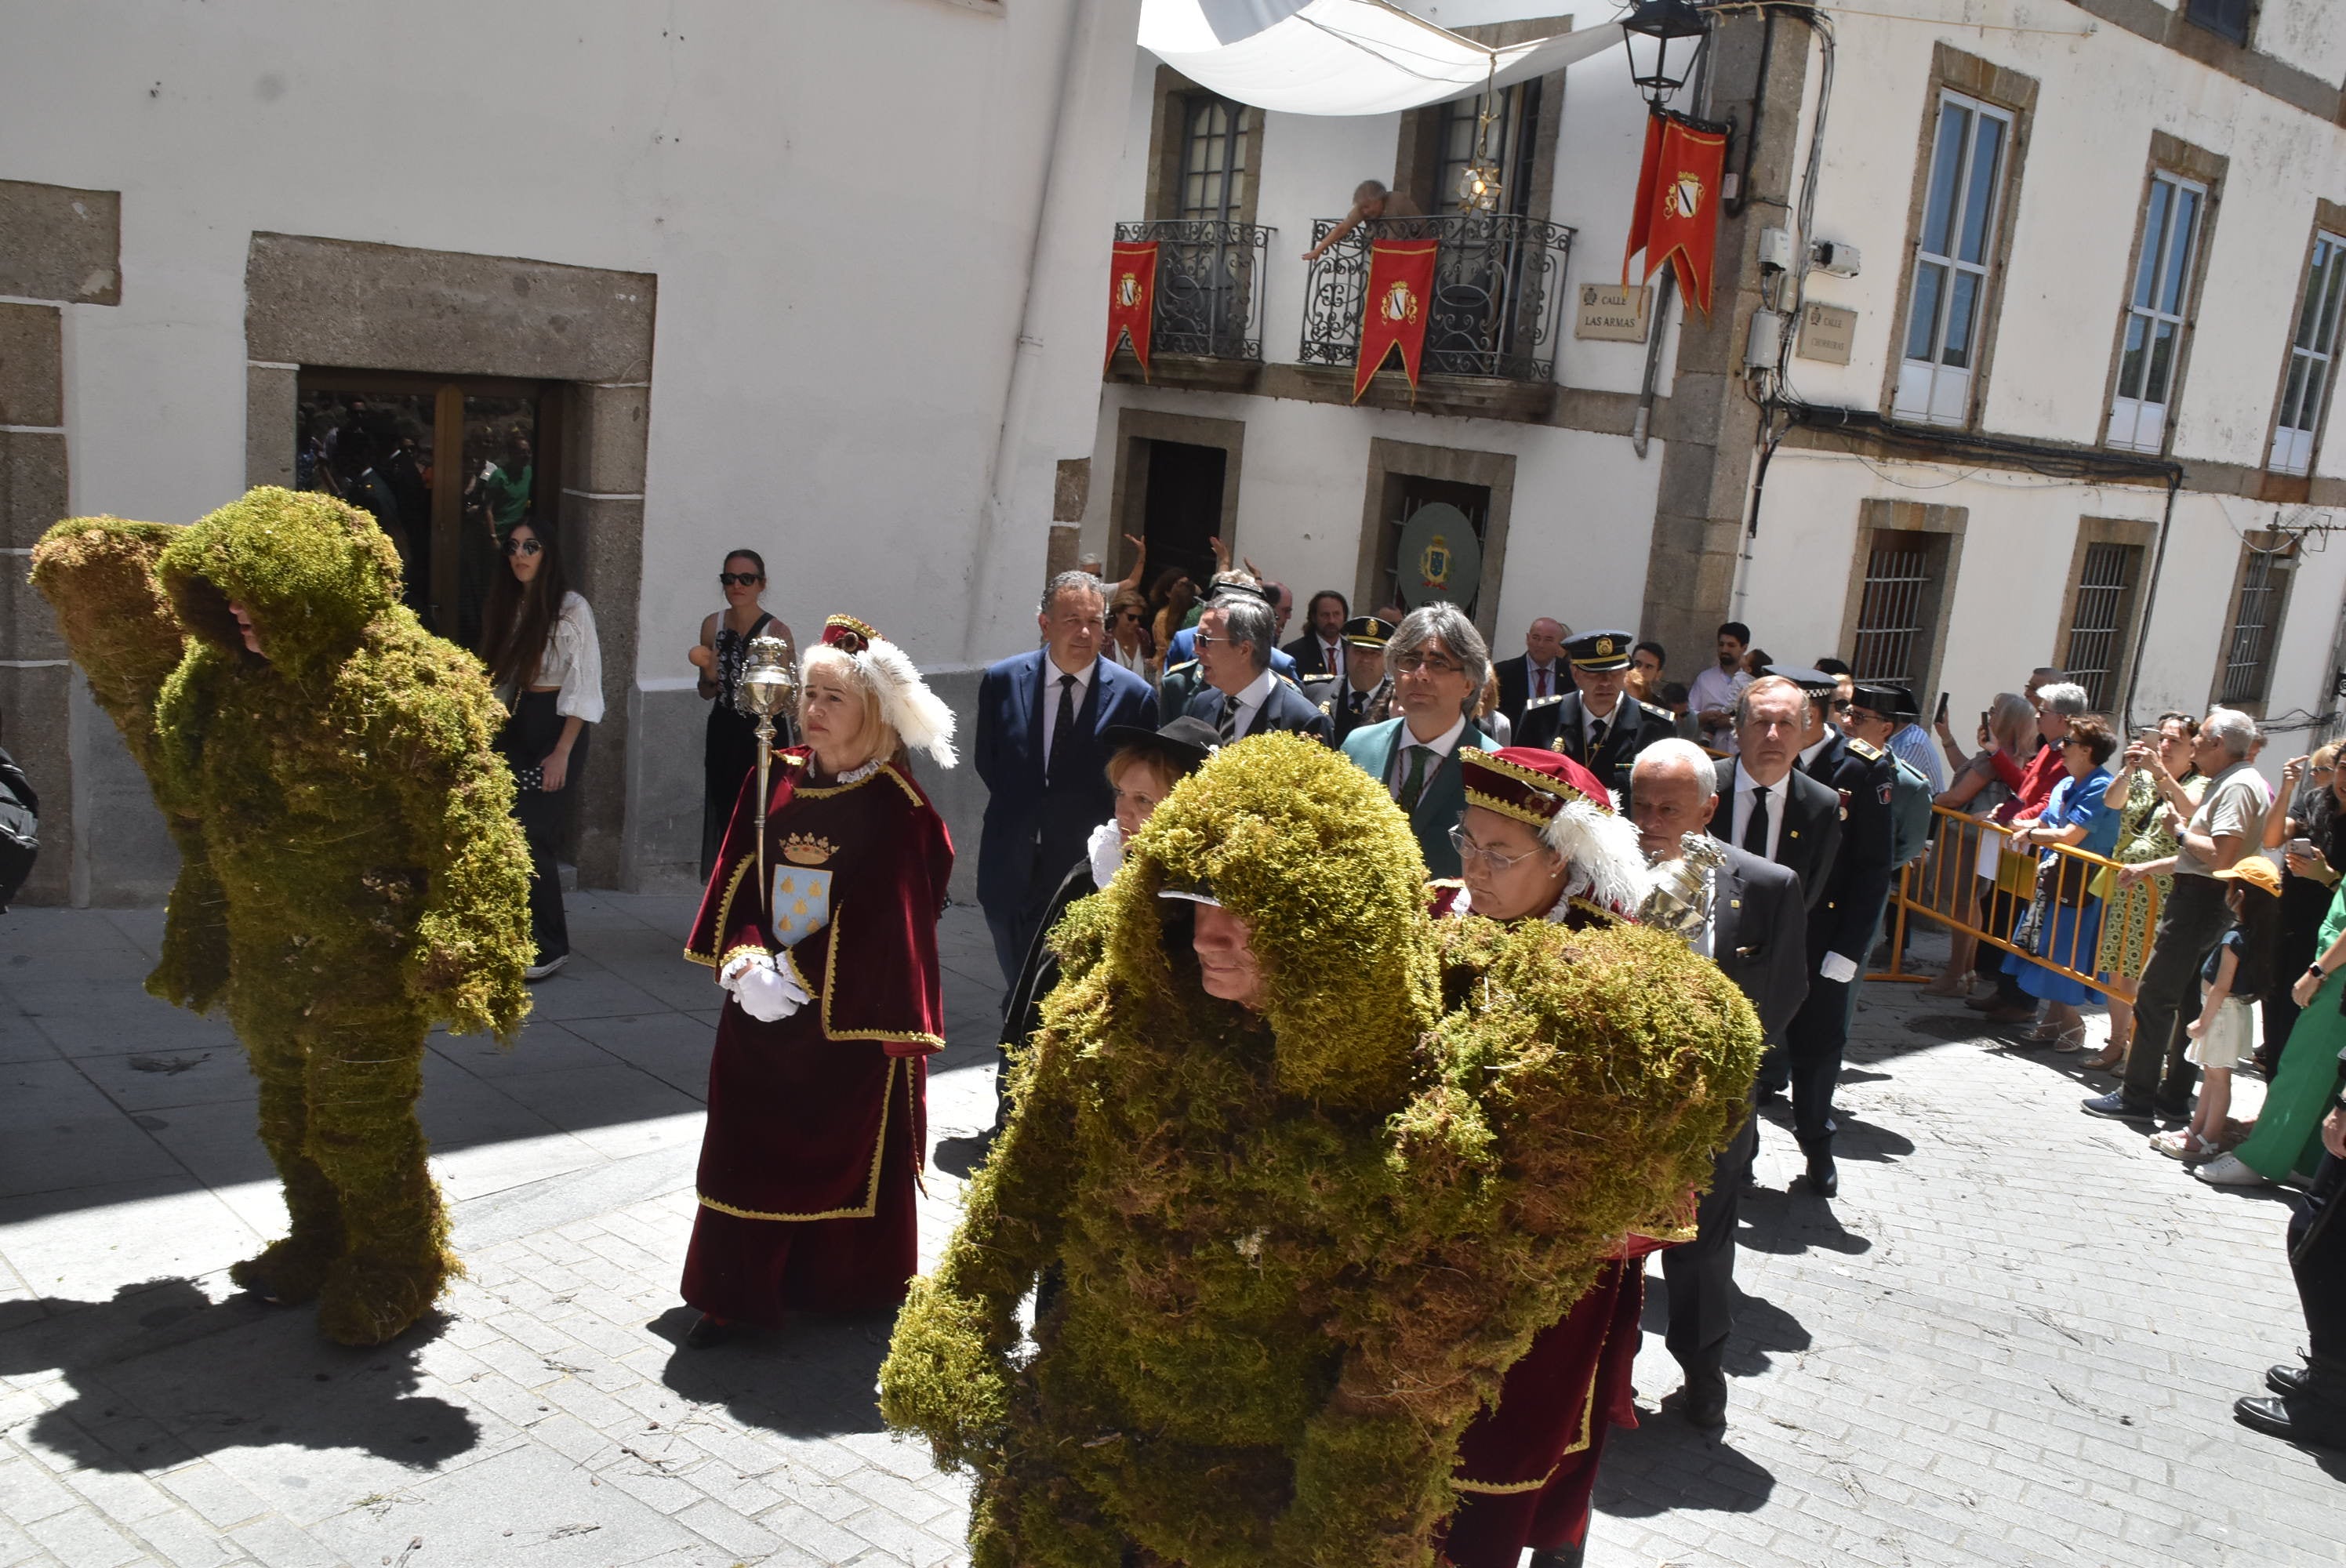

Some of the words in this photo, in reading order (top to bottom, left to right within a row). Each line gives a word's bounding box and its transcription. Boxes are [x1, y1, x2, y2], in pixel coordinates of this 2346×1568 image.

[1601, 296, 1627, 306] CALLE
[1585, 316, 1602, 327] LAS
[1603, 318, 1636, 328] ARMAS
[1824, 318, 1843, 328] CALLE
